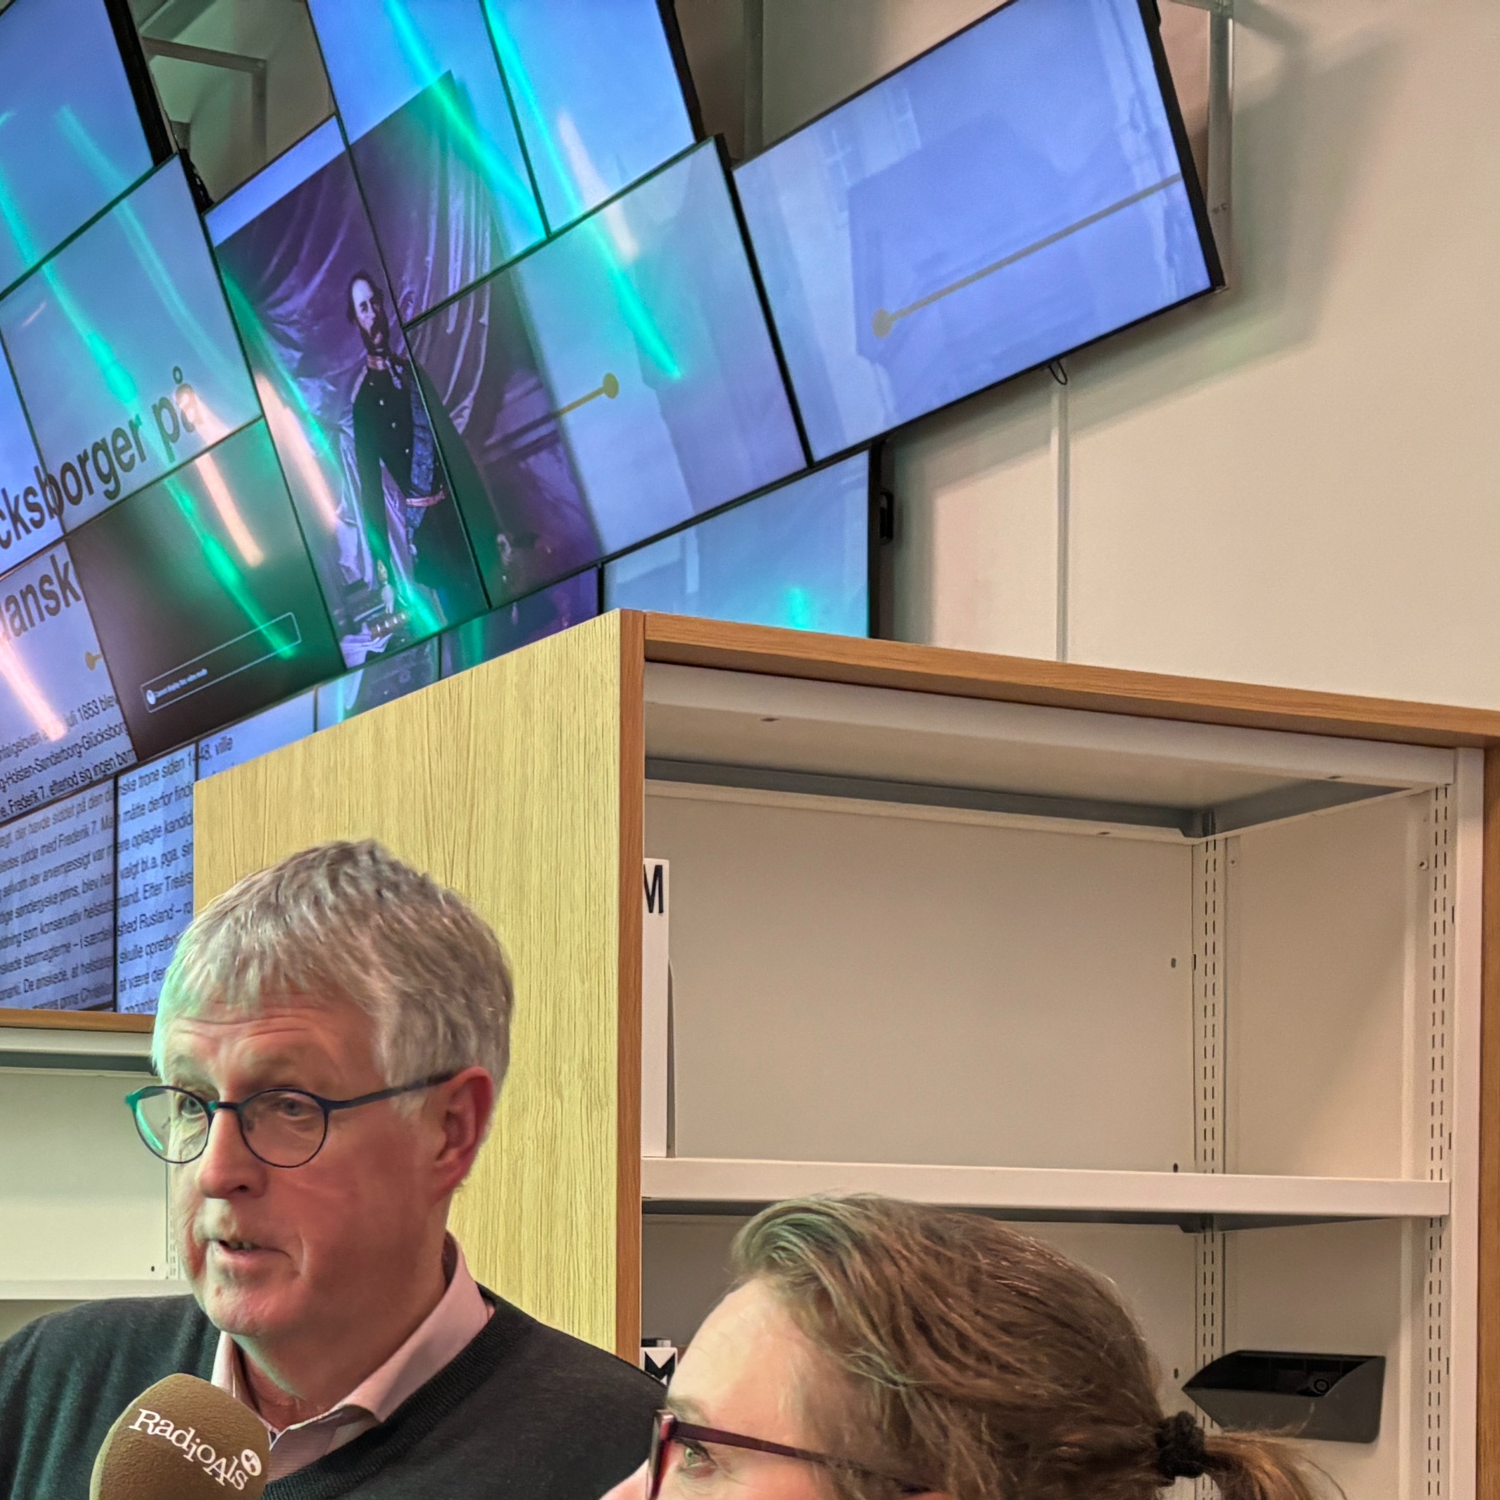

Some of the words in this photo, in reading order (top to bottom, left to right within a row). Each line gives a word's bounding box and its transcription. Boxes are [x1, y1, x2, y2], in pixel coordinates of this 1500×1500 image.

[151, 366, 204, 464] på
[76, 701, 100, 721] 1853
[23, 976, 33, 992] De
